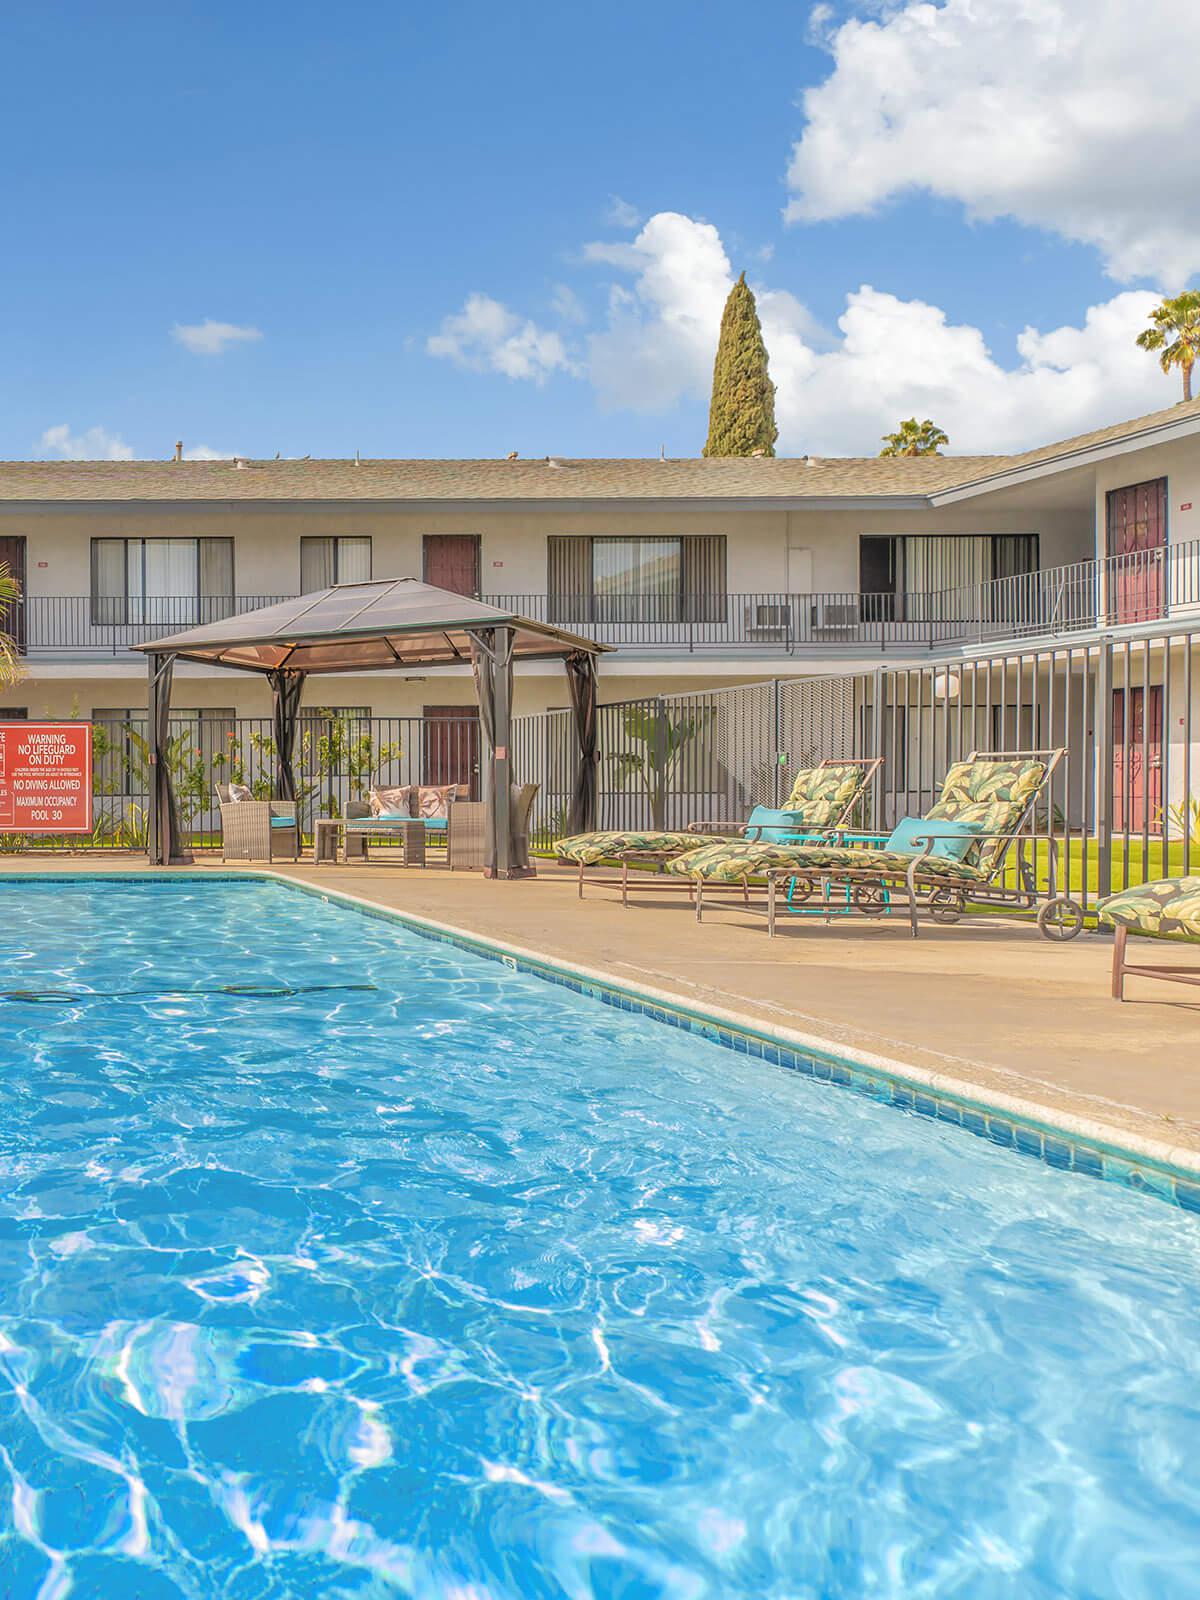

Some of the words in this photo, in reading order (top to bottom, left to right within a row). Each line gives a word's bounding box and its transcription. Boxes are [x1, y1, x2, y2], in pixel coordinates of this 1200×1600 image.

[28, 734, 66, 744] WARNING
[18, 745, 30, 754] NO
[33, 745, 75, 754] LIFEGUARD
[29, 755, 42, 764] ON
[44, 755, 64, 764] DUTY
[14, 780, 24, 790] NO
[26, 780, 48, 790] DIVING
[49, 780, 80, 790] ALLOWED
[16, 796, 44, 806] MAXIMUM
[45, 796, 77, 806] OCCUPANCY
[32, 810, 49, 820] POOL
[52, 810, 62, 820] 30
